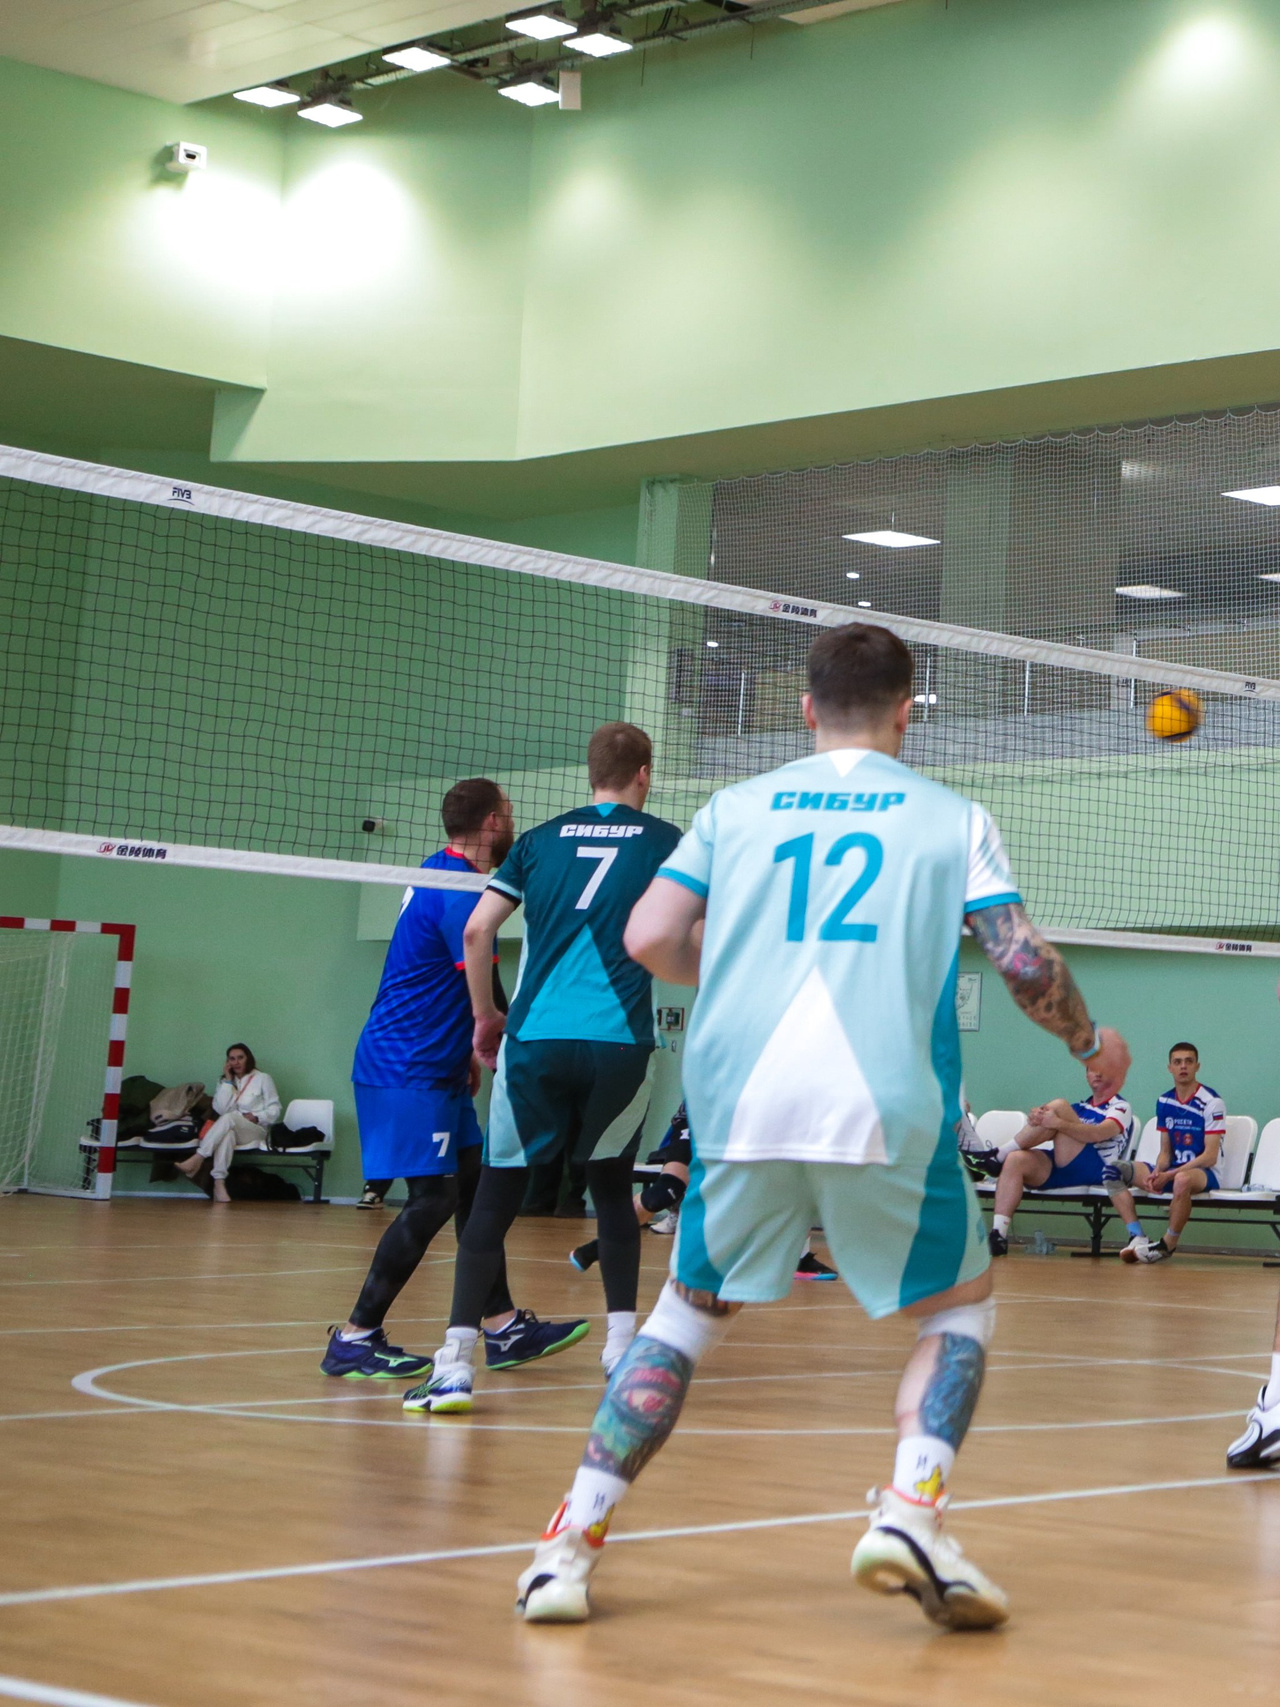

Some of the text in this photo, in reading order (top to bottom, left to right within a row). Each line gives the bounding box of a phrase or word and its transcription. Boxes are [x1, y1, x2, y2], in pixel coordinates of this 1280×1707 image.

[172, 487, 192, 500] FIVB
[770, 791, 906, 812] СИБУР
[559, 824, 644, 838] СИБУР
[117, 845, 167, 859] 金陵体育
[574, 846, 619, 910] 7
[773, 831, 884, 943] 12
[432, 1132, 451, 1158] 7
